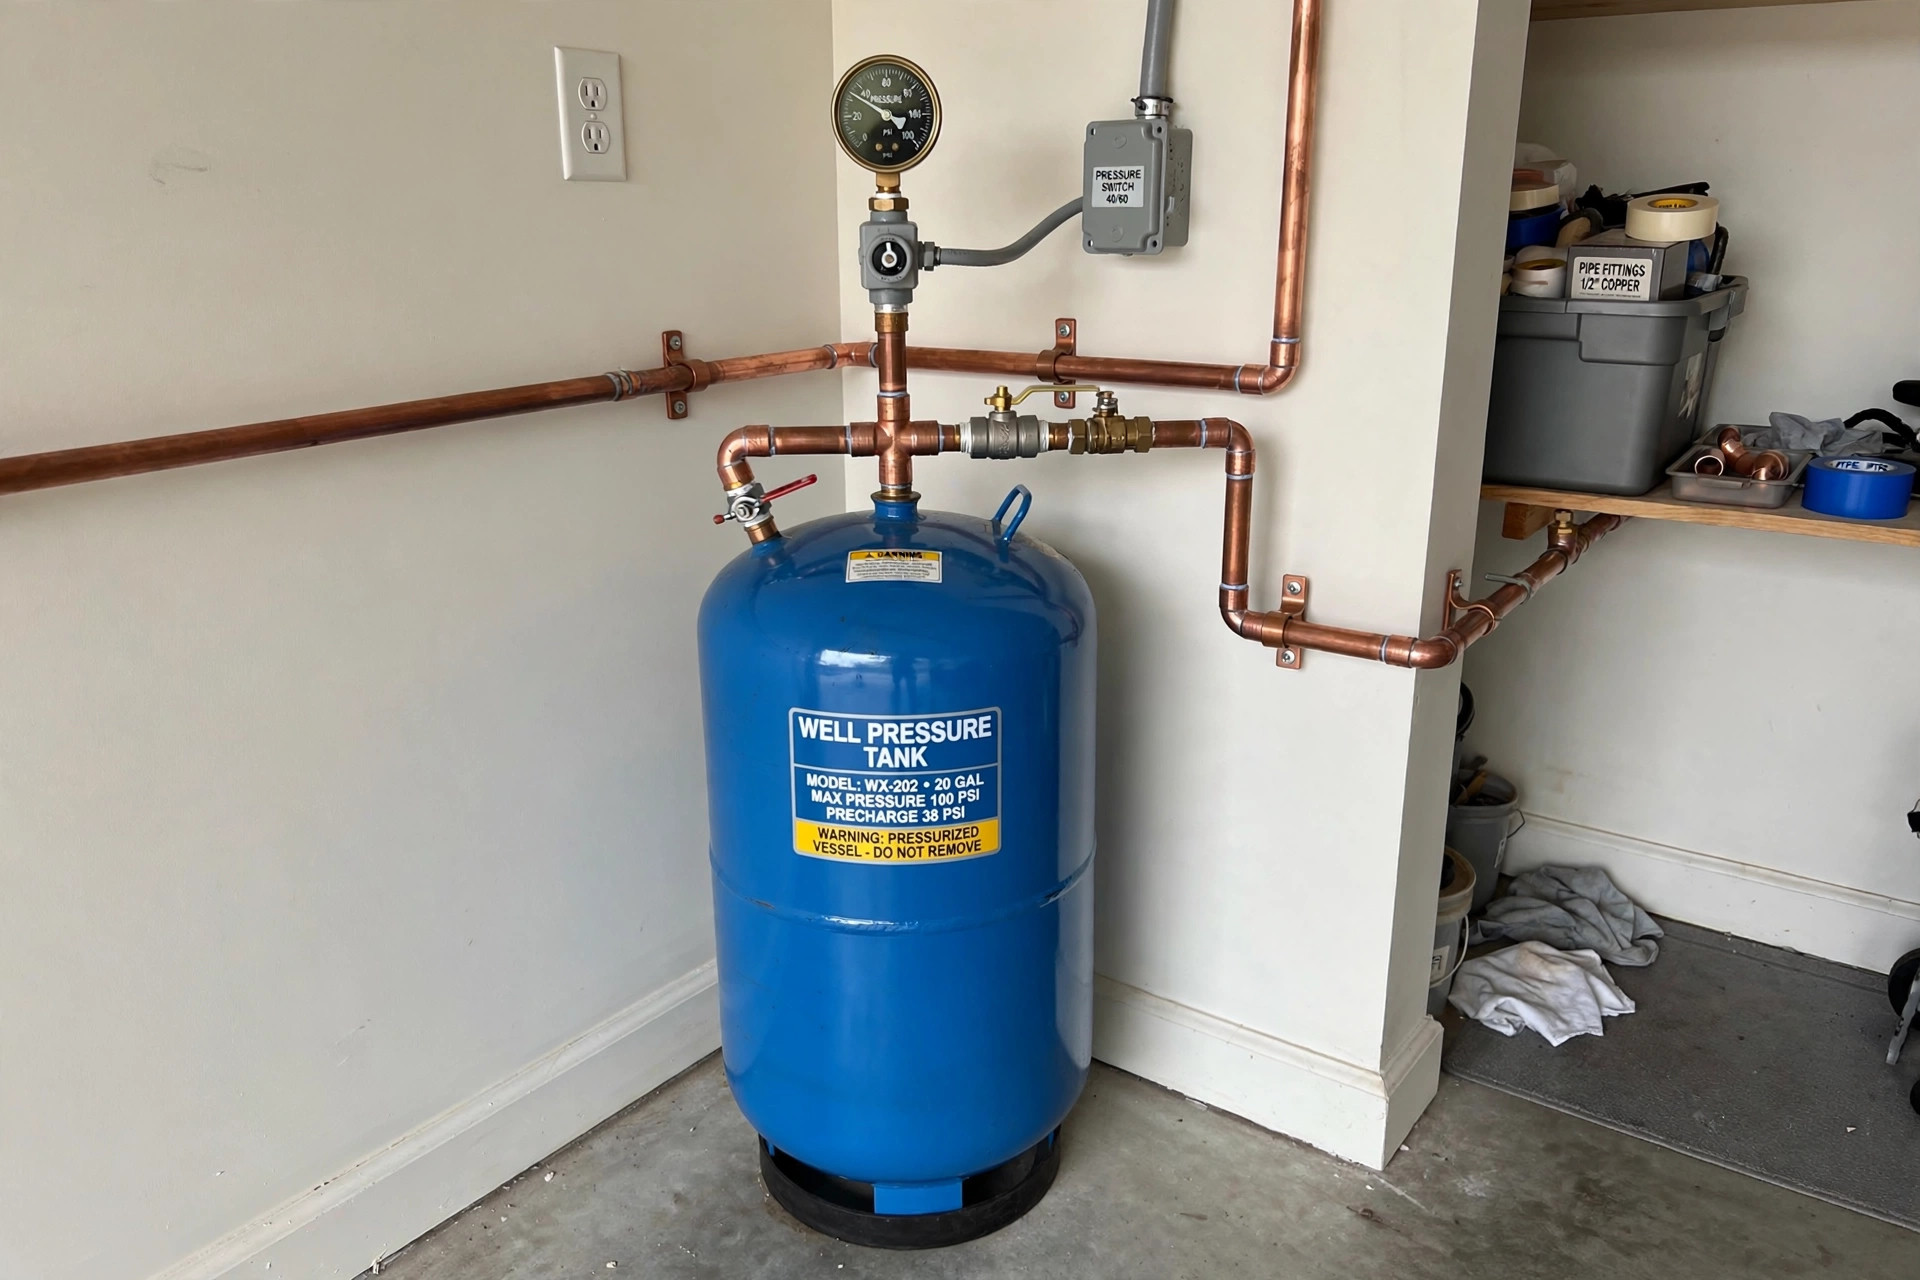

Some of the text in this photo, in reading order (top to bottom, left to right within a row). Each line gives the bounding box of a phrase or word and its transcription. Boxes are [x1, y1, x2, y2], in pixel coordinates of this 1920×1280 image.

[860, 89, 871, 98] 40
[852, 111, 862, 120] 20
[902, 130, 914, 140] 100
[1095, 170, 1141, 180] PRESSURE
[1101, 182, 1135, 192] SWITCH
[1579, 262, 1646, 277] PIPE FITTINGS
[1601, 278, 1641, 292] COPPER
[798, 715, 992, 744] WELL PRESSURE
[863, 746, 928, 768] TANK
[806, 773, 861, 791] MODEL:
[864, 778, 918, 792] WX-202
[935, 778, 950, 791] 20
[954, 773, 984, 788] GAL
[811, 789, 980, 809] MAX PRESSURE 100 PSI
[826, 806, 965, 823] PRECHARGE 38 PSI
[817, 825, 979, 844] WARNING: PRESSURIZED
[813, 840, 862, 857] VESSEL
[873, 846, 893, 859] DO
[897, 846, 924, 858] NOT
[928, 839, 981, 857] REMOVE
